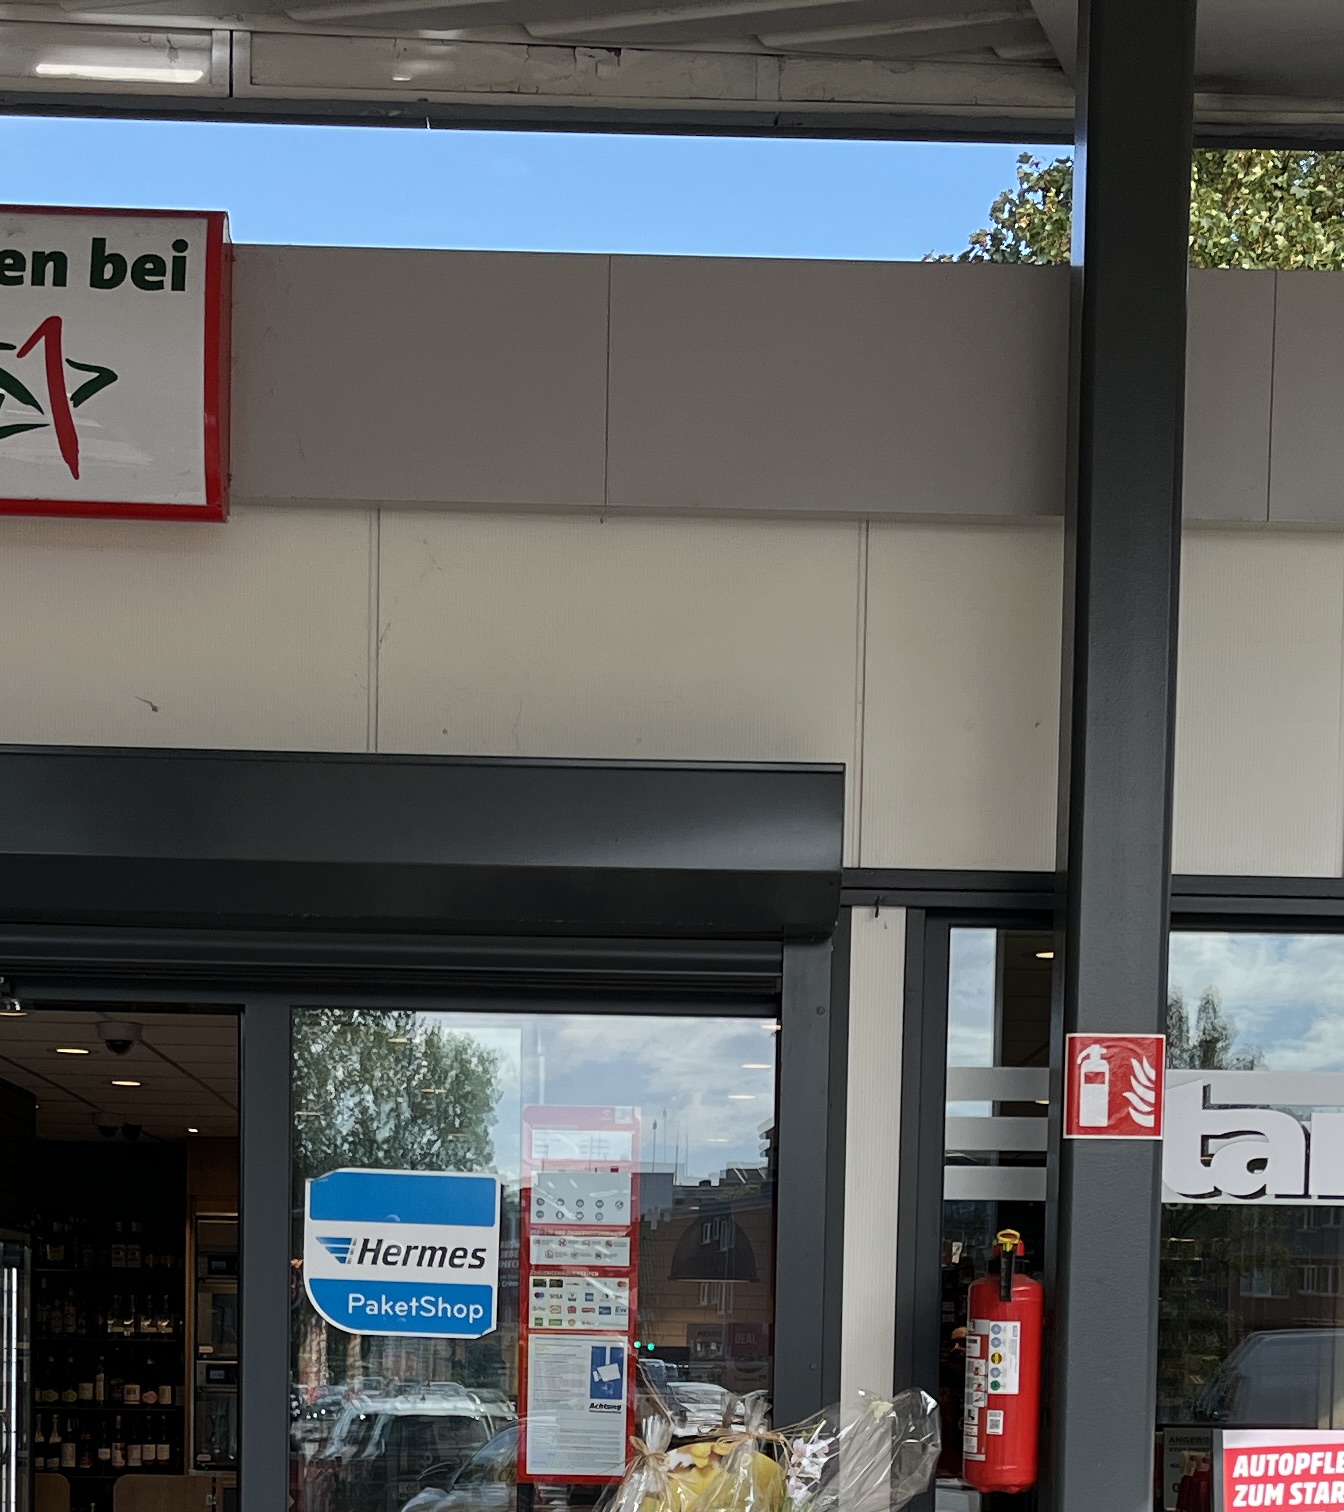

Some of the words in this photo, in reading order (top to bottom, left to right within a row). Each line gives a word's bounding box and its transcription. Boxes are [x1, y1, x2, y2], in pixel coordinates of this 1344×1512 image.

[88, 237, 188, 292] bei
[357, 1238, 487, 1270] Hermes
[347, 1293, 484, 1324] PaketShop
[1232, 1482, 1285, 1507] ZUM
